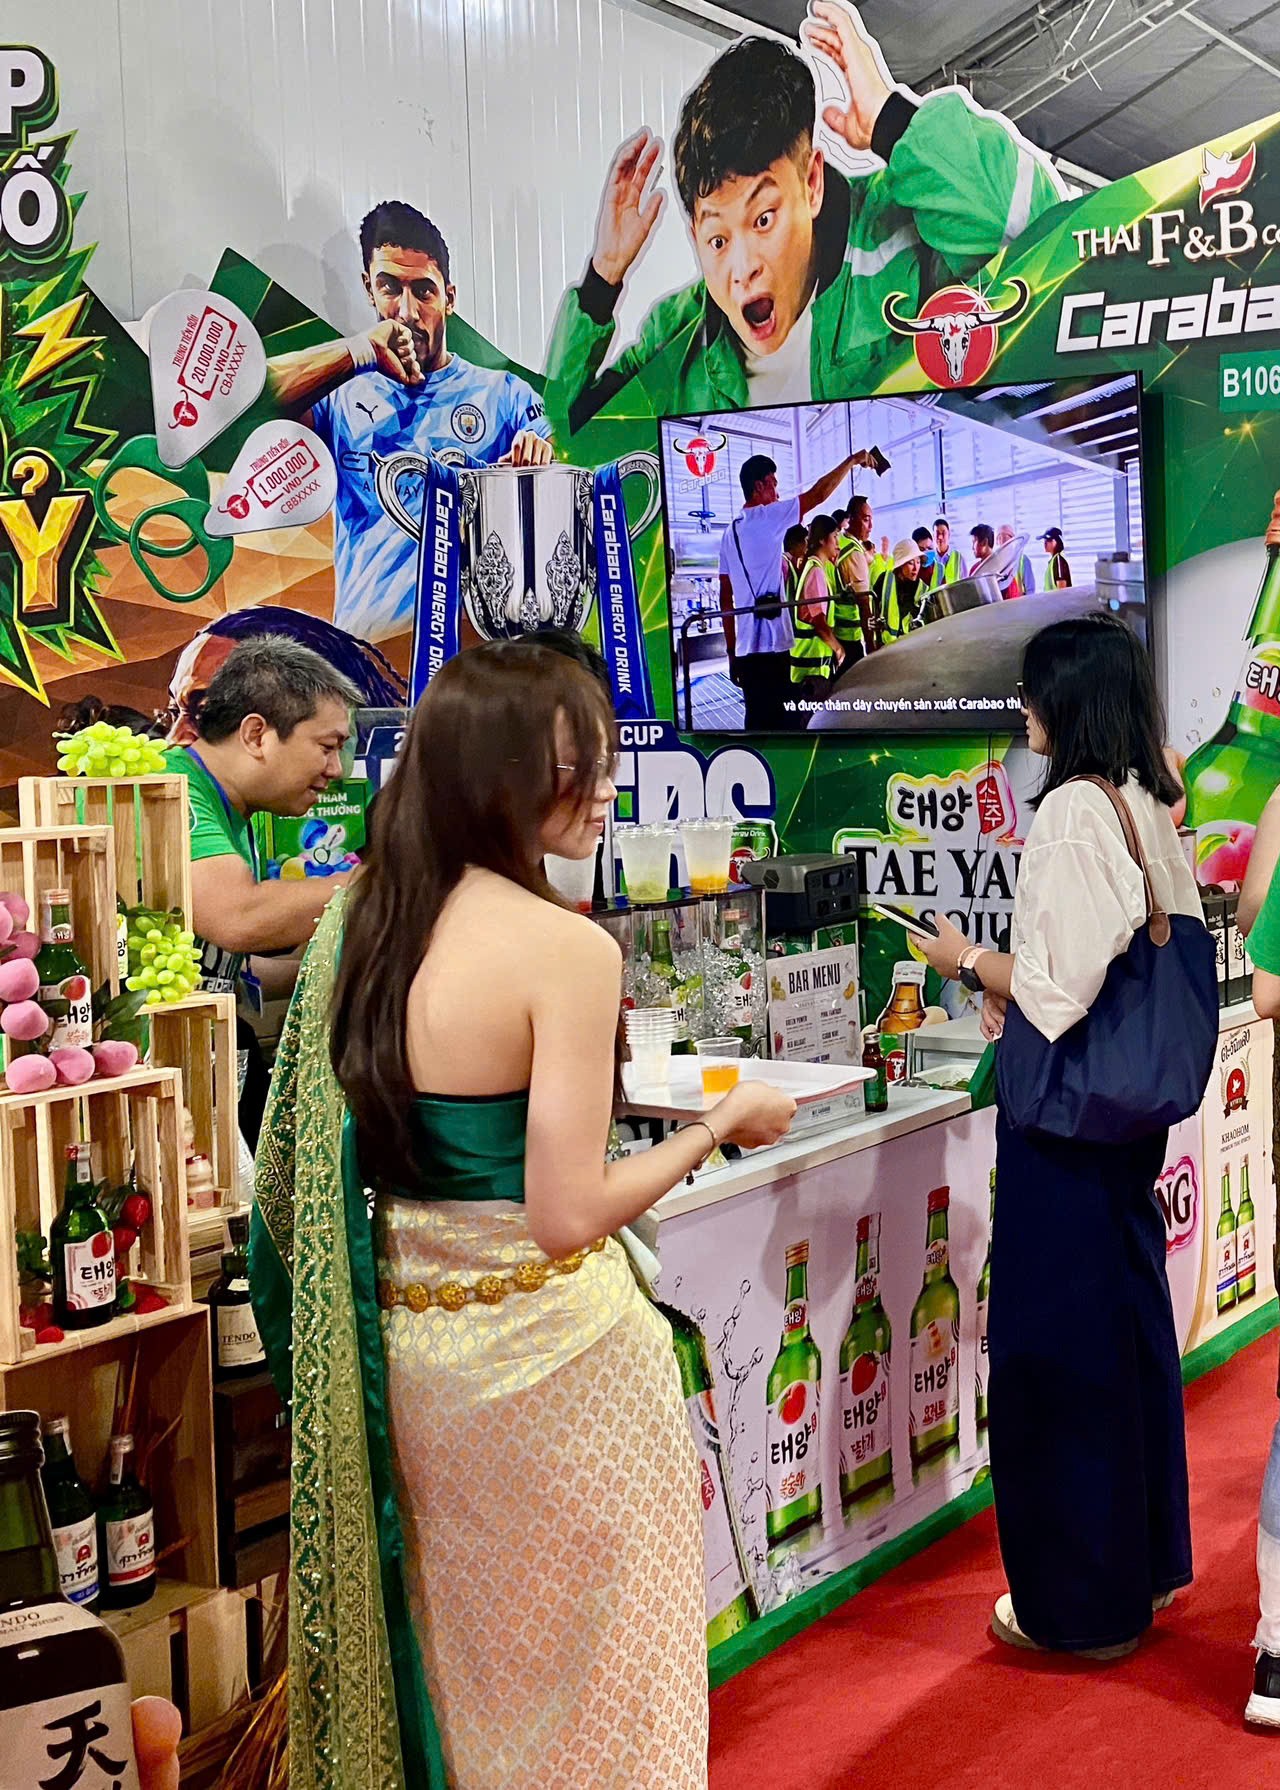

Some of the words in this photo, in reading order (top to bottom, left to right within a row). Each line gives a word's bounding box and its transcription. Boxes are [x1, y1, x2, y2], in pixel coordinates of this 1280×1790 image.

[0, 146, 57, 246] Ố
[1072, 223, 1141, 259] THAI
[1146, 200, 1257, 266] F&B
[191, 321, 223, 384] 20.000.000
[214, 349, 230, 372] VND
[259, 452, 307, 495] 1.000.000
[282, 476, 302, 494] VND
[433, 487, 453, 579] Carabao
[600, 494, 622, 580] Carabao
[430, 581, 448, 644] ENERGY
[609, 584, 627, 643] ENERGY
[614, 646, 632, 694] DRINK
[783, 699, 797, 711] và
[934, 696, 957, 710] xuất
[959, 697, 1005, 710] Carabao
[620, 725, 664, 745] CUP
[897, 785, 973, 832] 태양
[978, 782, 1002, 828] 소주
[844, 846, 939, 897] TAE
[947, 848, 1021, 899] YA
[788, 969, 809, 995] BAR
[812, 963, 841, 989] MENU
[1221, 1124, 1250, 1145] KHAOHOM
[222, 1331, 256, 1344] TENDO
[914, 1357, 951, 1393] 태양
[844, 1391, 882, 1429] 태양
[771, 1422, 812, 1465] 태양
[38, 1700, 128, 1790] 天
